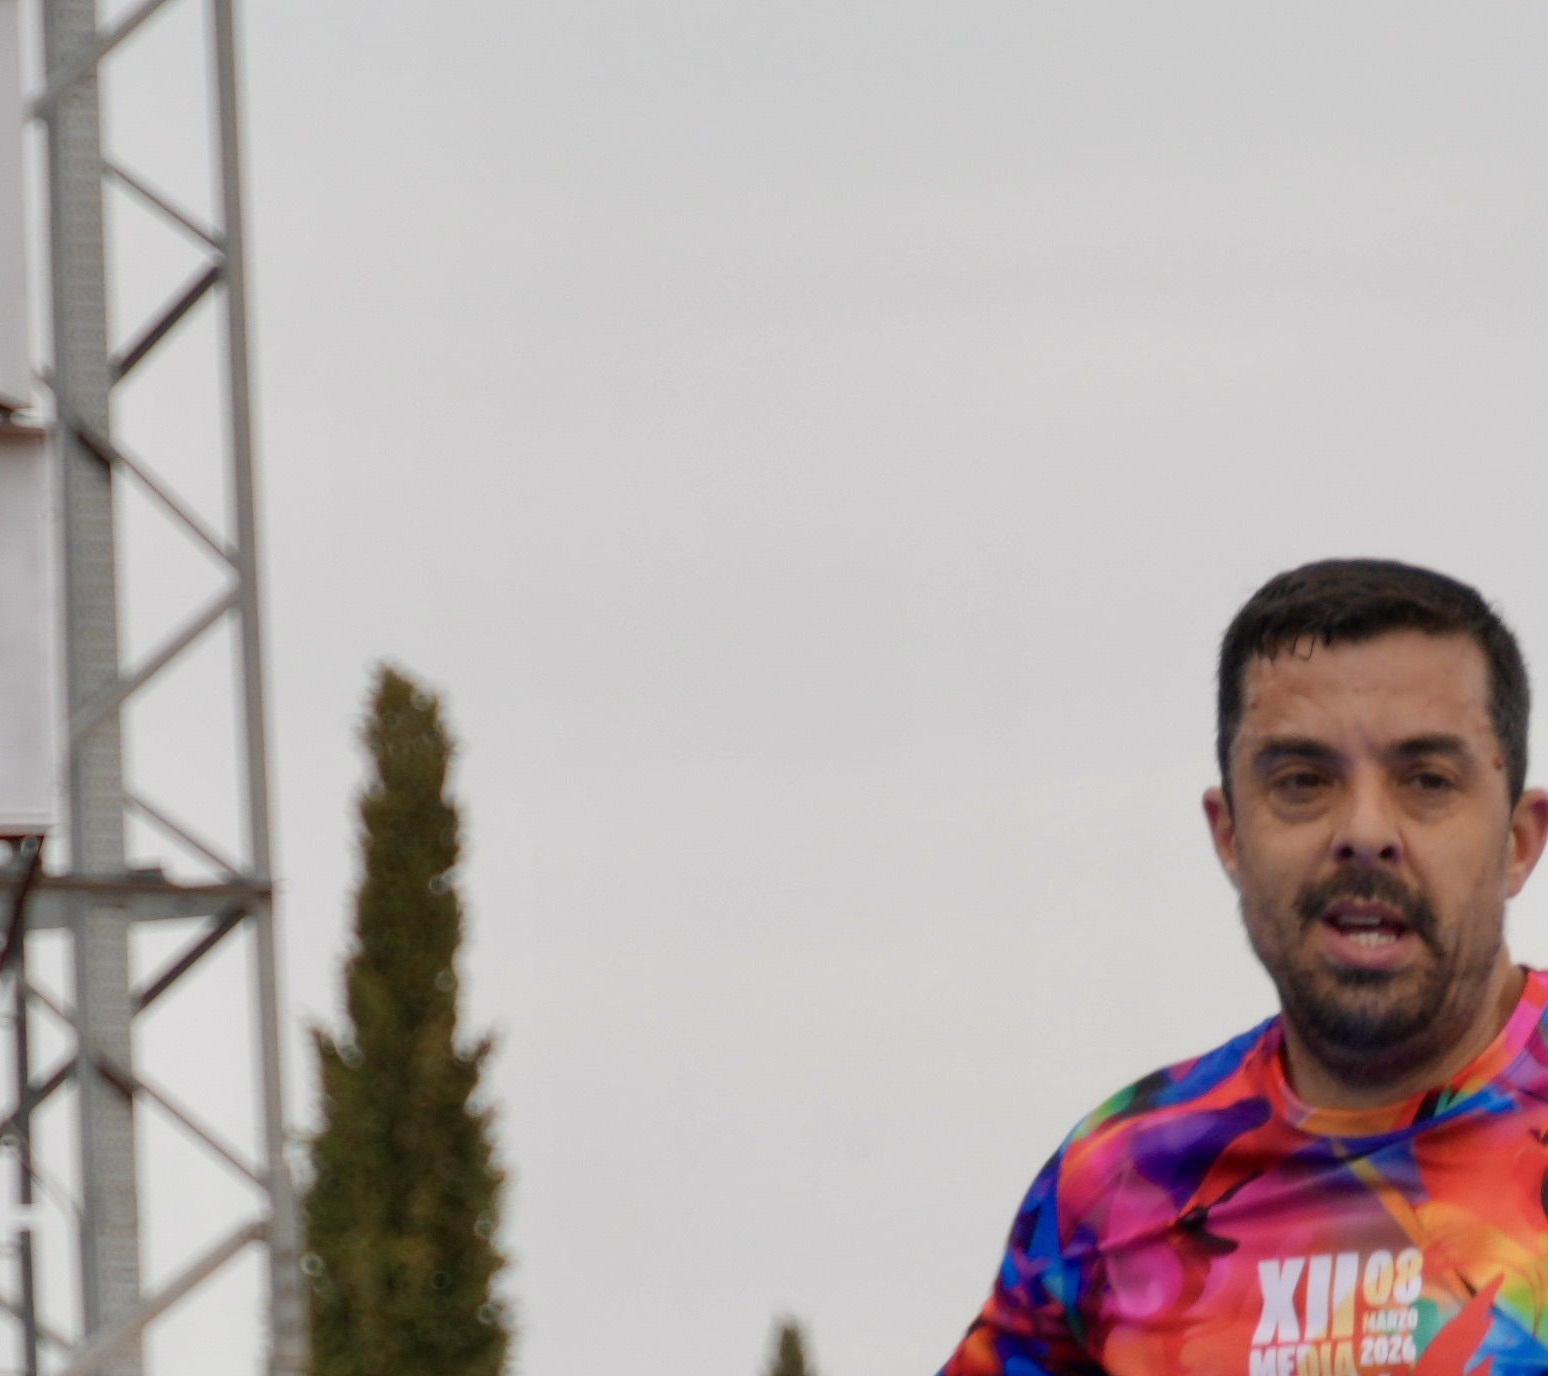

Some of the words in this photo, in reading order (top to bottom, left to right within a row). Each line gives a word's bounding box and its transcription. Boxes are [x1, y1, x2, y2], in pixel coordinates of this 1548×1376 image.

[1252, 1252, 1359, 1345] XII
[1363, 1248, 1423, 1305] 08
[1362, 1307, 1419, 1332] MARZO
